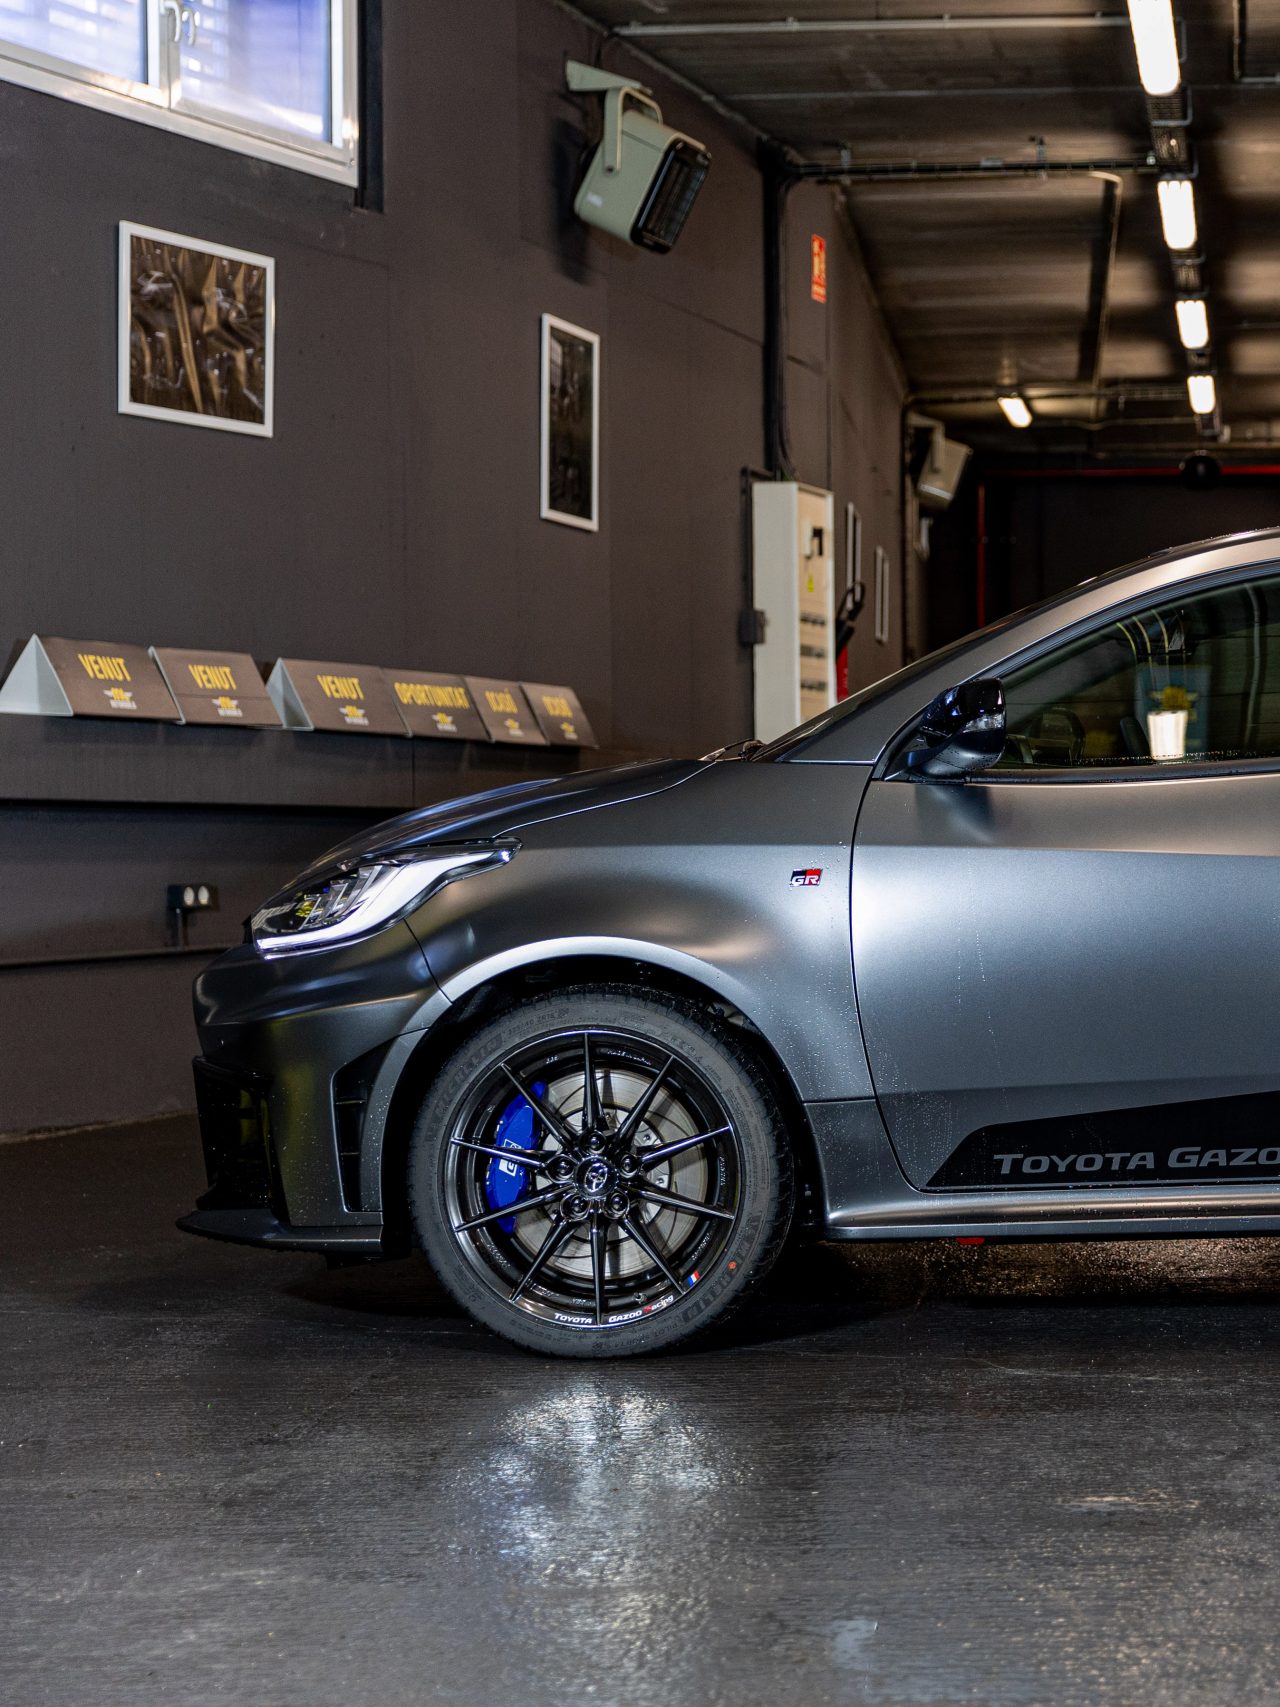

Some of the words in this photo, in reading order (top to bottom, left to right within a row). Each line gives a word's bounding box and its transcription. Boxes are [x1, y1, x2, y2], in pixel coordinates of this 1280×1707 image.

[78, 654, 131, 682] VENUT
[188, 664, 237, 690] VENUT
[317, 675, 364, 700] VENUT
[791, 875, 820, 886] GR
[994, 1150, 1156, 1176] TOYOTA
[554, 1312, 593, 1324] TOYOTA
[608, 1310, 642, 1323] GAZOO
[643, 1294, 674, 1313] Racing
